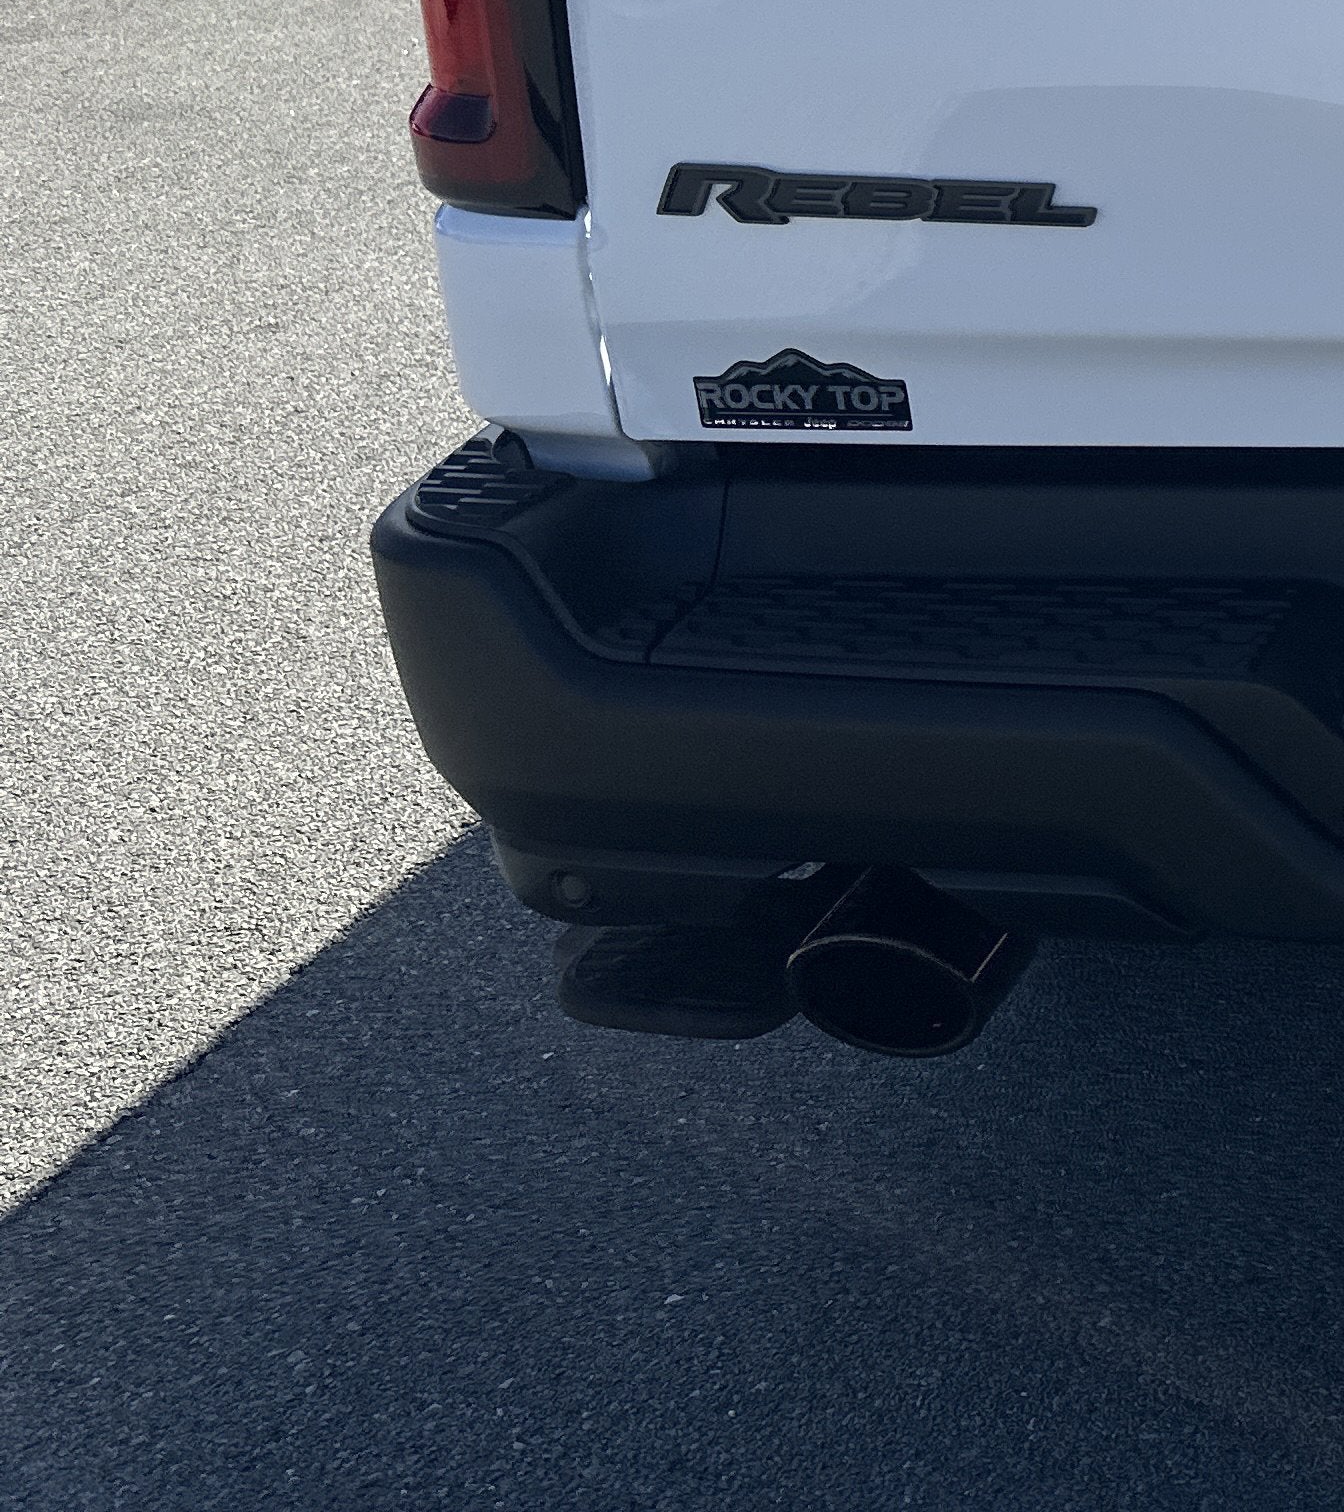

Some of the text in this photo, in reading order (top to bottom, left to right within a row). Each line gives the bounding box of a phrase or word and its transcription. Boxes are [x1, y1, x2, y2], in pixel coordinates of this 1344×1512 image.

[656, 162, 1098, 227] REBEL
[695, 382, 904, 411] ROCKY TOP
